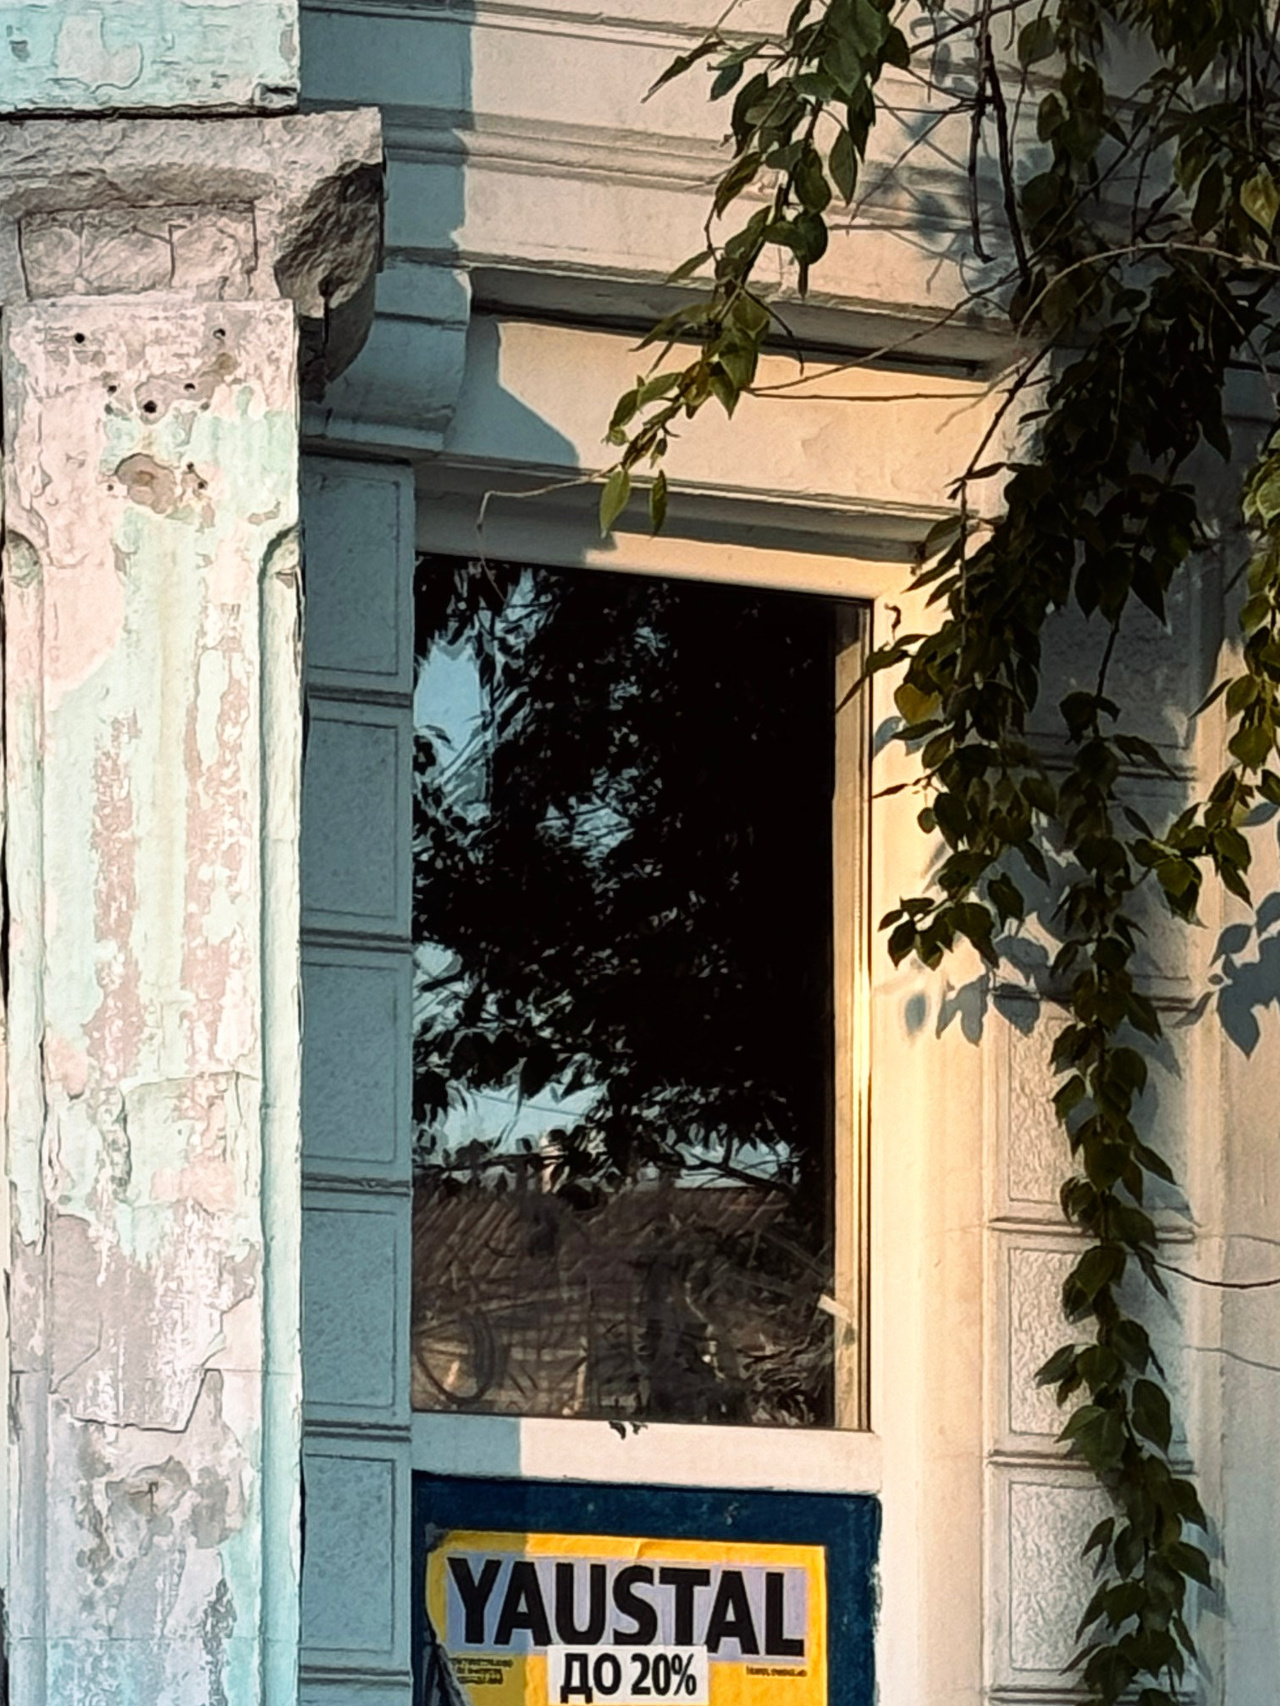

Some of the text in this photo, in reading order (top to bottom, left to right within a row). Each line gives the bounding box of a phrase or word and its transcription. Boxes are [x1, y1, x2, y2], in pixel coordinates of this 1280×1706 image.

[447, 1556, 805, 1657] YAUSTAL
[560, 1653, 622, 1704] ДО
[631, 1653, 698, 1696] 20%
